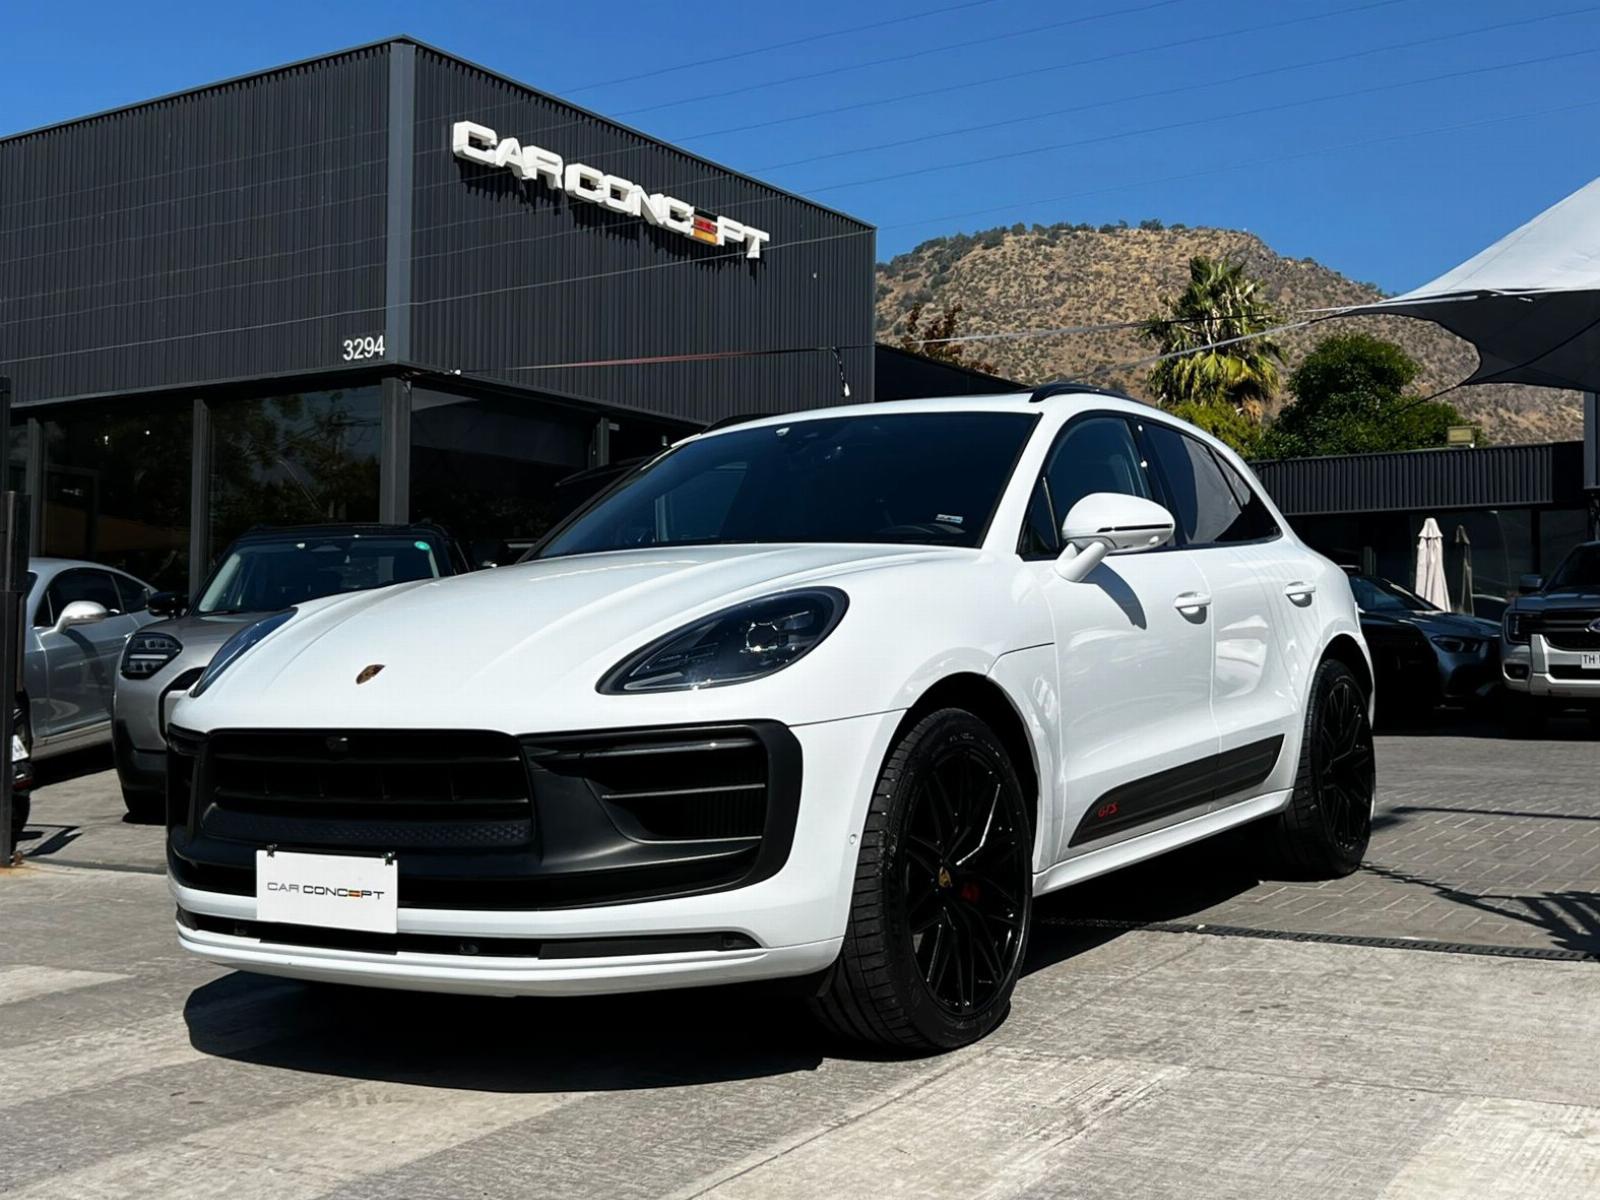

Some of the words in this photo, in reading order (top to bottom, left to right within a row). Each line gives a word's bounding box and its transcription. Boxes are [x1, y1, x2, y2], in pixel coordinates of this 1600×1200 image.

[453, 121, 563, 190] CAR
[565, 163, 770, 259] CONCEPT
[343, 335, 385, 361] 3294
[1098, 801, 1118, 819] GTS
[267, 882, 299, 893] CAR
[303, 885, 385, 900] CONCEPT
